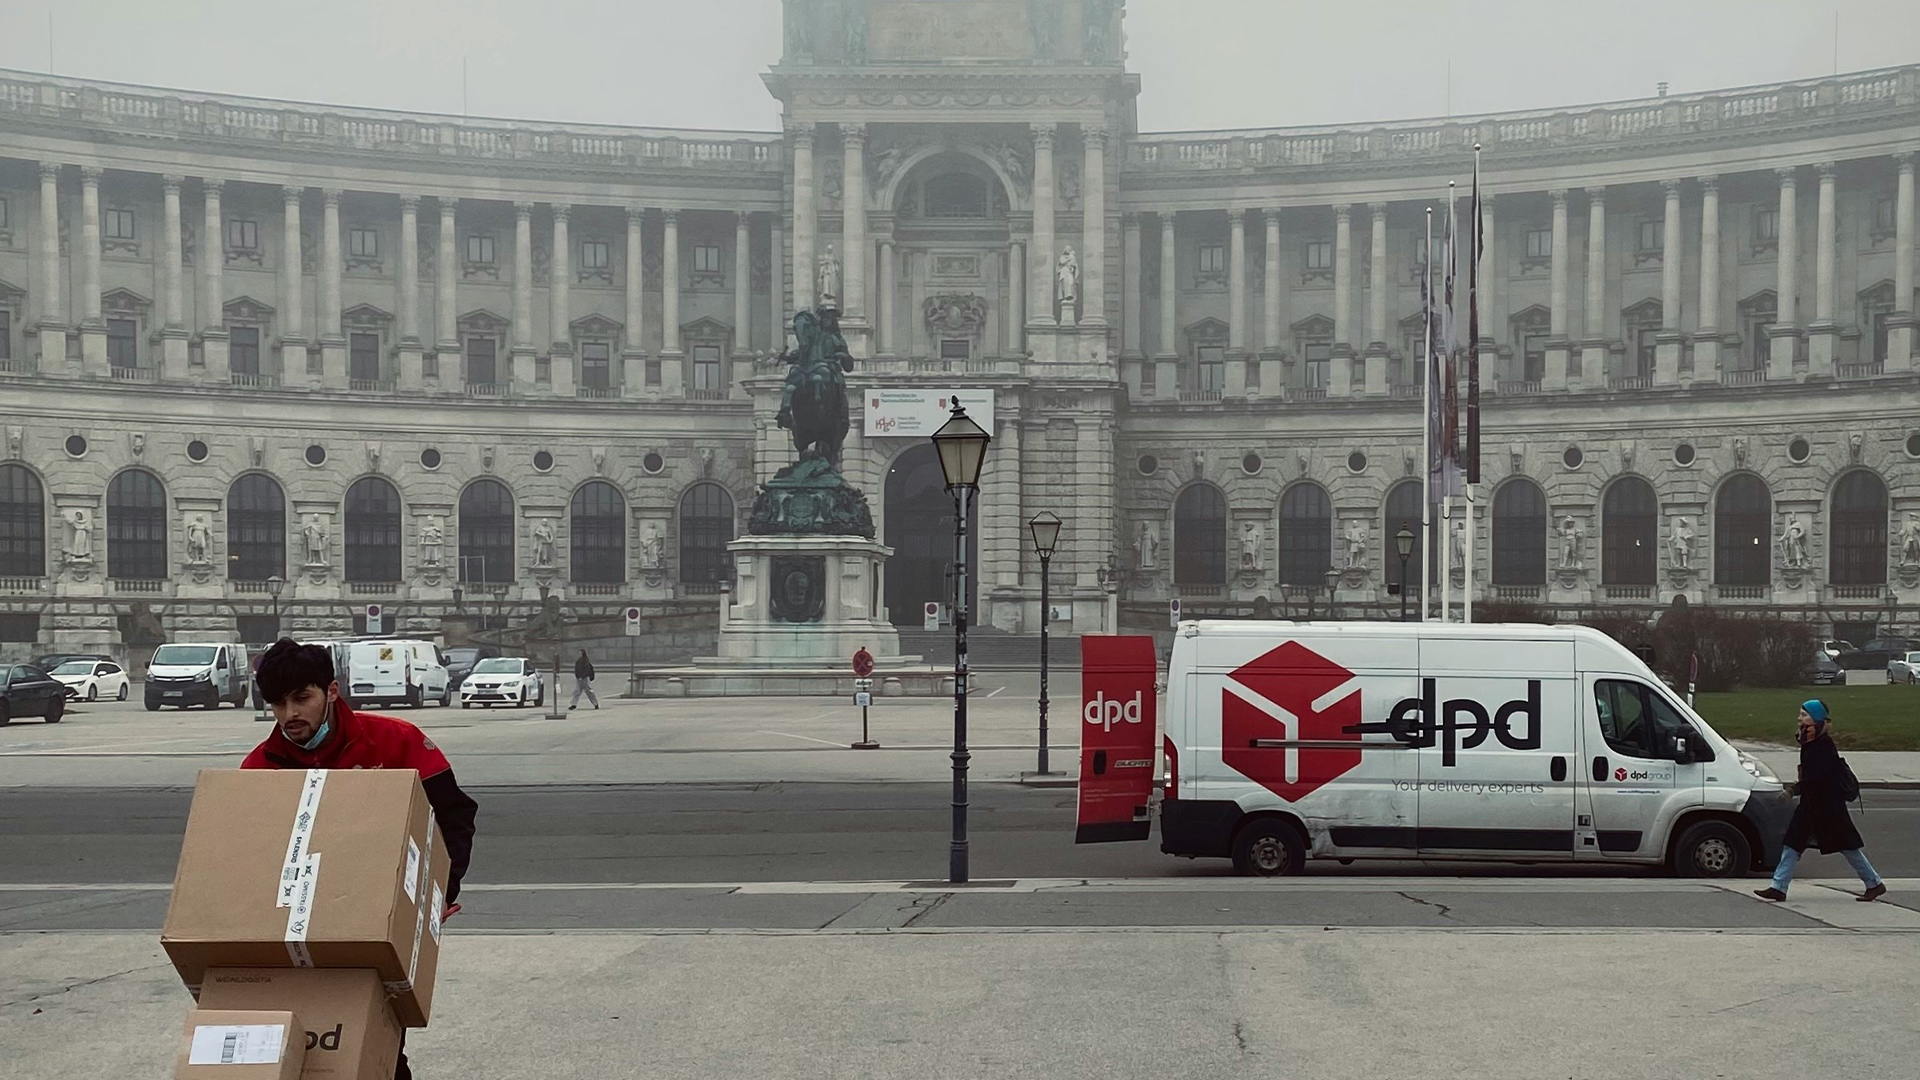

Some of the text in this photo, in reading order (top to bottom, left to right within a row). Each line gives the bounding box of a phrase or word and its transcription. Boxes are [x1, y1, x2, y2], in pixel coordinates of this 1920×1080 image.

[1084, 690, 1142, 732] dpd
[1389, 678, 1541, 767] dpd
[1391, 779, 1544, 795] Your delivery experts
[305, 1023, 343, 1051] pd
